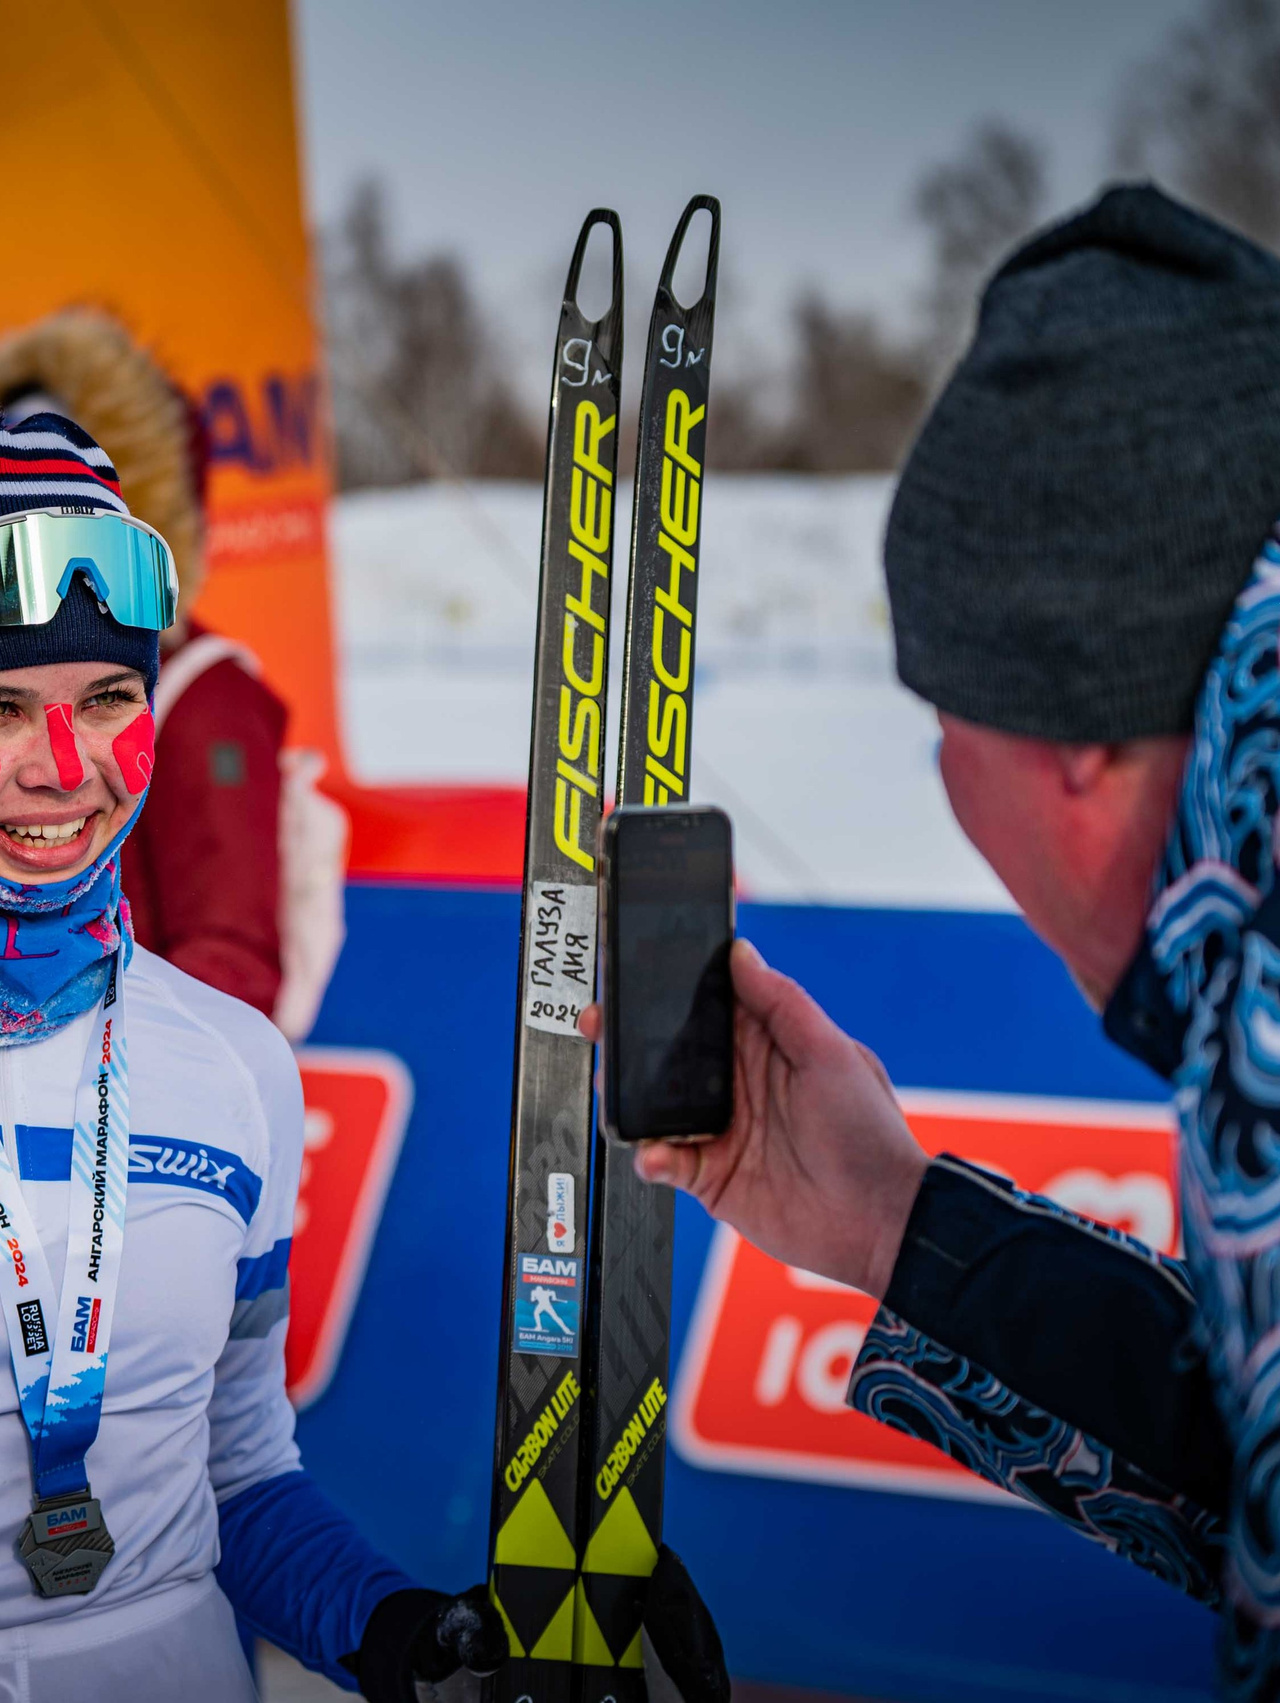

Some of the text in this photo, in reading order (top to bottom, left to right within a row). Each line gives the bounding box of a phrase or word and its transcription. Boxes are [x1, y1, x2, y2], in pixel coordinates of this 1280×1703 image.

[644, 388, 706, 806] ISCHER
[554, 400, 616, 873] FISCHER
[531, 889, 566, 987] ГАЛУЗА
[101, 1018, 113, 1065] 2024
[530, 1000, 581, 1030] 2024
[96, 1071, 110, 1167] МАРАФОН
[87, 1169, 108, 1283] АНГАРСКИЙ
[6, 1237, 29, 1288] 2024
[522, 1257, 577, 1277] БАМ
[70, 1296, 92, 1353] БАМ
[504, 1370, 582, 1493] CARBON LITE
[595, 1376, 668, 1500] CARBON LITE
[537, 1444, 563, 1479] SKATE
[627, 1454, 649, 1487] SKATE
[46, 1506, 87, 1527] БАМ
